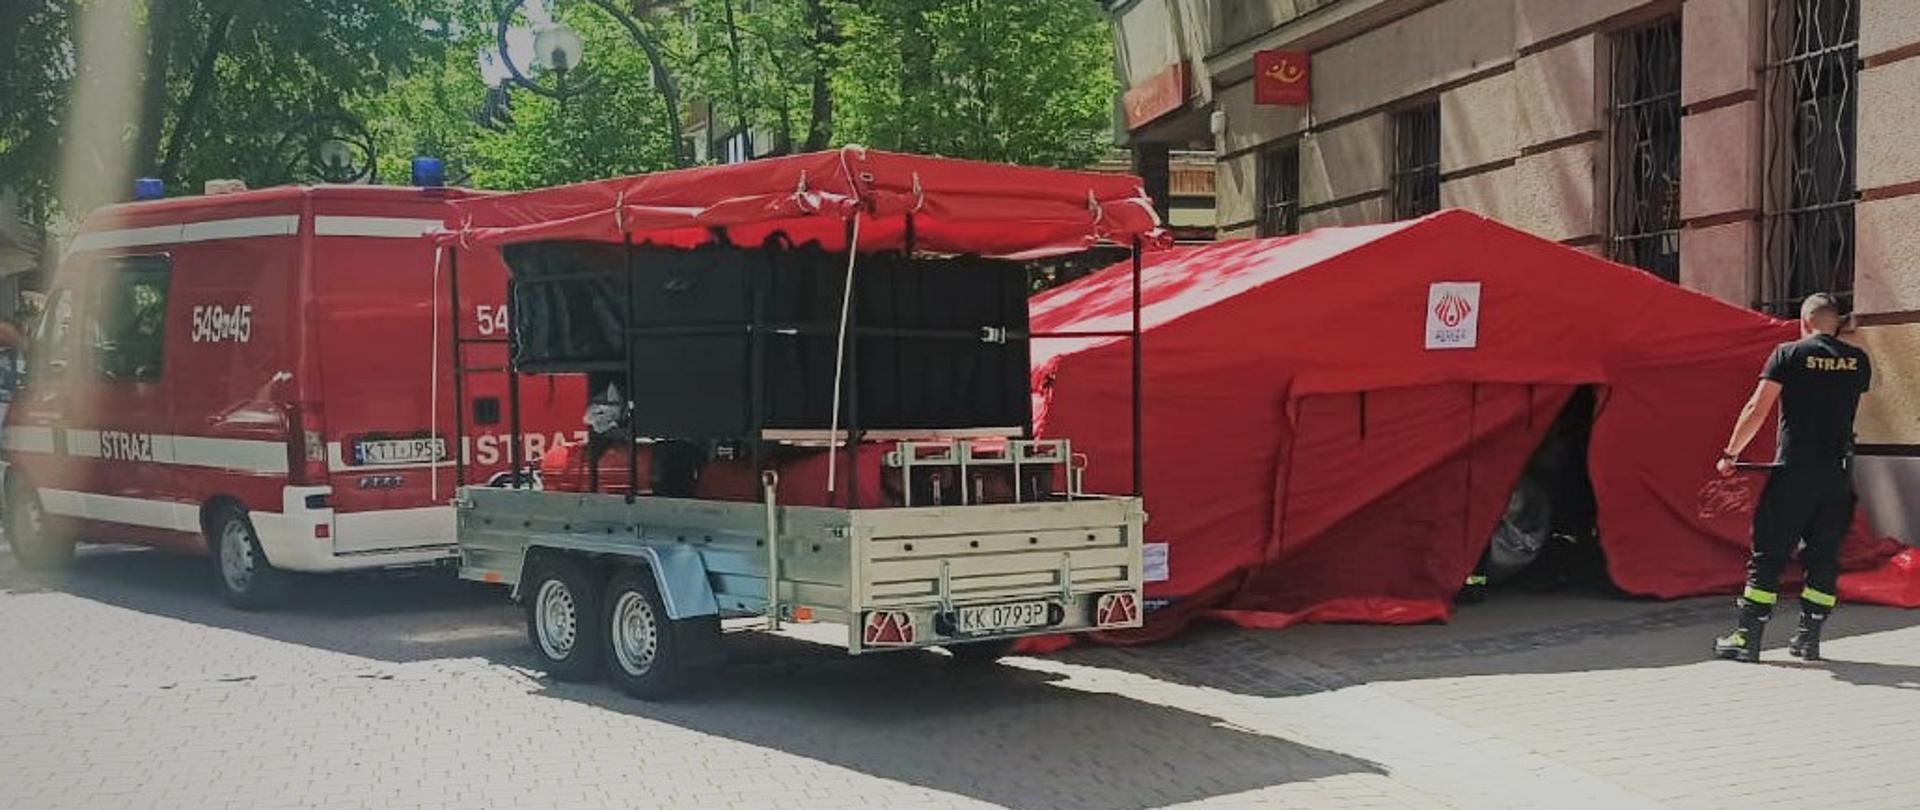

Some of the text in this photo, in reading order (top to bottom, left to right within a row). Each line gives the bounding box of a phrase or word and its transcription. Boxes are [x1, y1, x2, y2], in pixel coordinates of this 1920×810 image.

[365, 442, 397, 460] KTT
[963, 603, 1043, 628] KK 0793P
